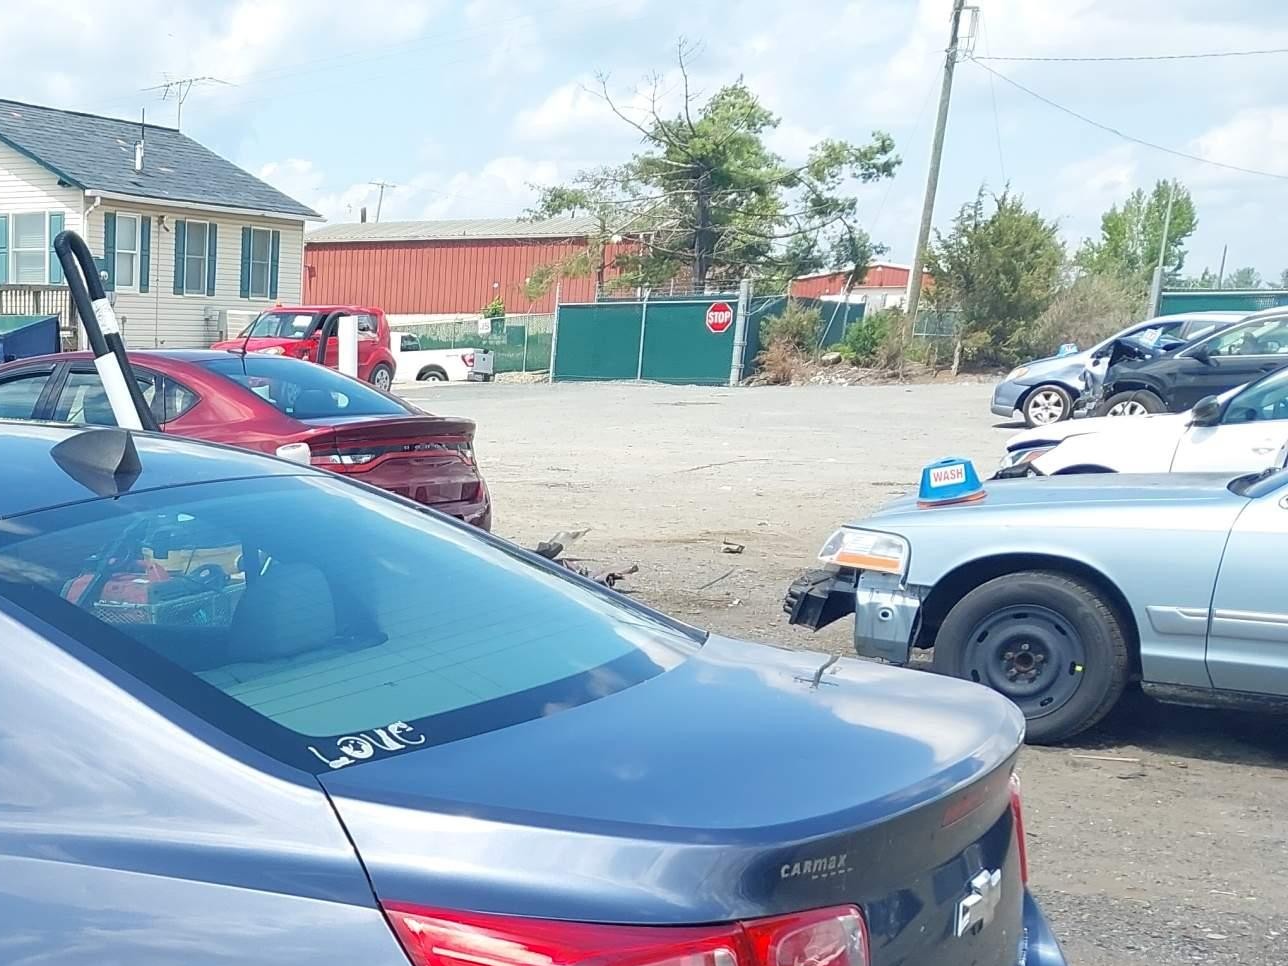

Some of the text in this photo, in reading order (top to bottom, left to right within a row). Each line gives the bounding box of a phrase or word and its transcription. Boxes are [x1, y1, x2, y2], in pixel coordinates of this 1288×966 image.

[708, 311, 731, 324] STOP
[933, 468, 963, 483] WASH
[308, 721, 426, 769] LOVE
